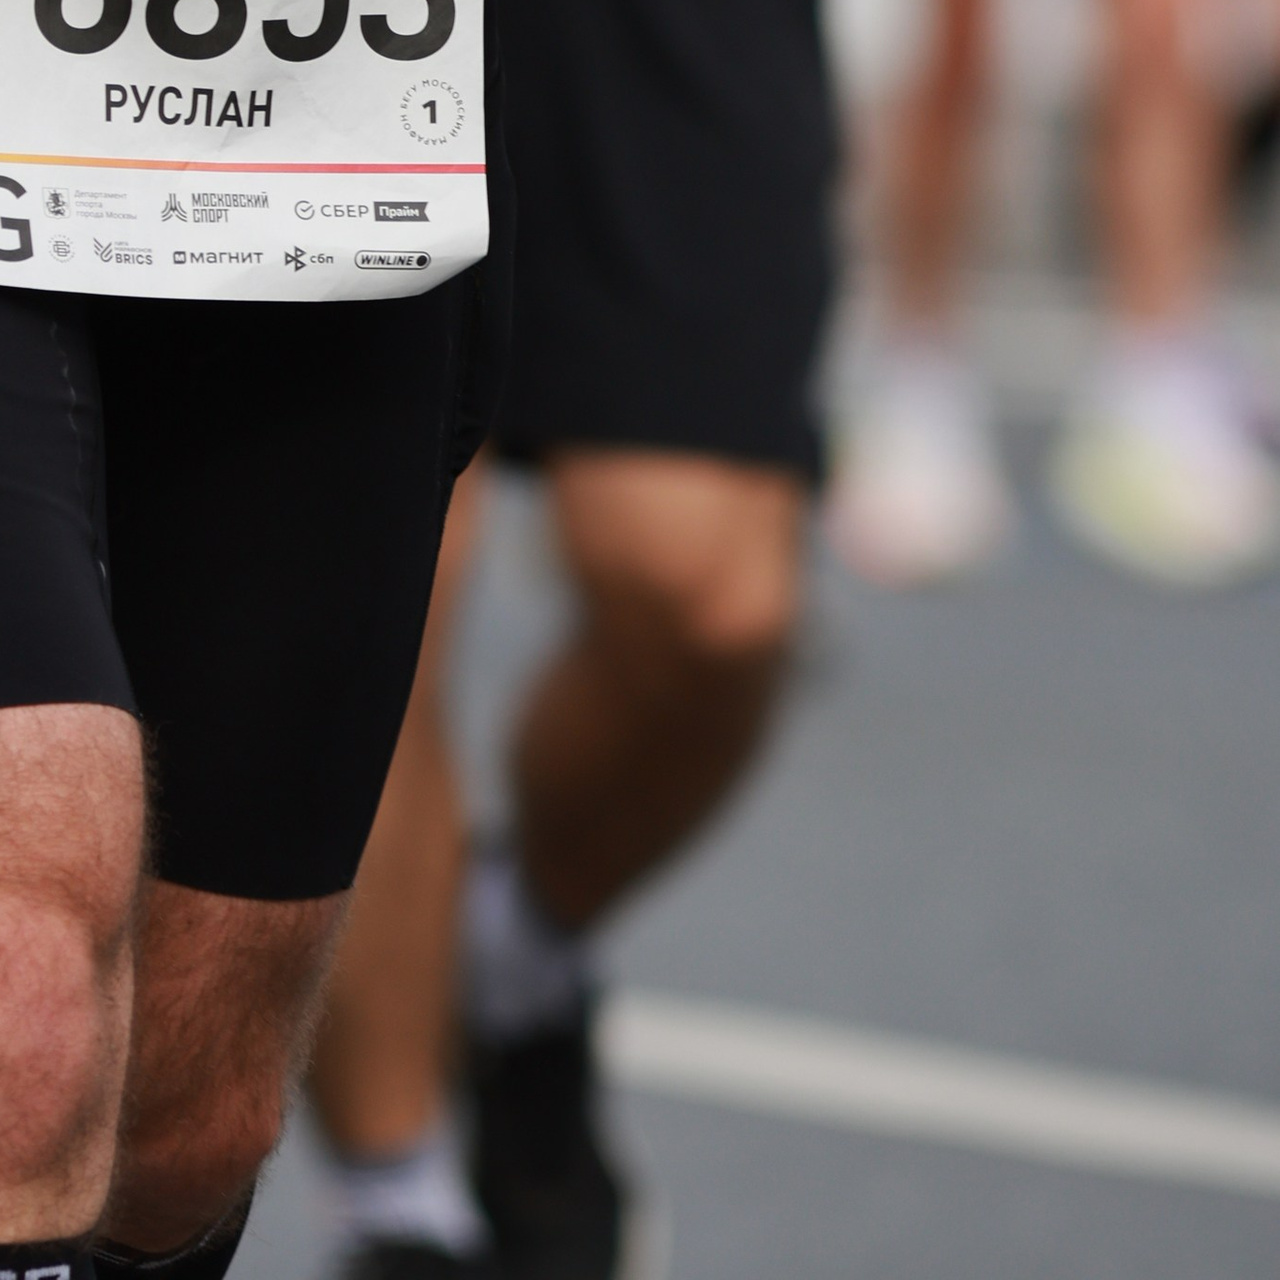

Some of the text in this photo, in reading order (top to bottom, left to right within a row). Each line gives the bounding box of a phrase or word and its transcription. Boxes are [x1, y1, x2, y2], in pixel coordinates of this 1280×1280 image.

[103, 84, 274, 128] РУСЛАН
[422, 79, 465, 137] МОСКОВСКИЙ
[422, 100, 437, 124] 1
[400, 114, 447, 146] МАРАФОН
[74, 190, 128, 200] Департамент
[191, 191, 270, 209] МОСКОВСКИЙ
[75, 201, 103, 209] спорта
[320, 204, 420, 219] СБЕР Прайм
[192, 209, 229, 223] СПОРТ
[115, 253, 153, 265] BRICS
